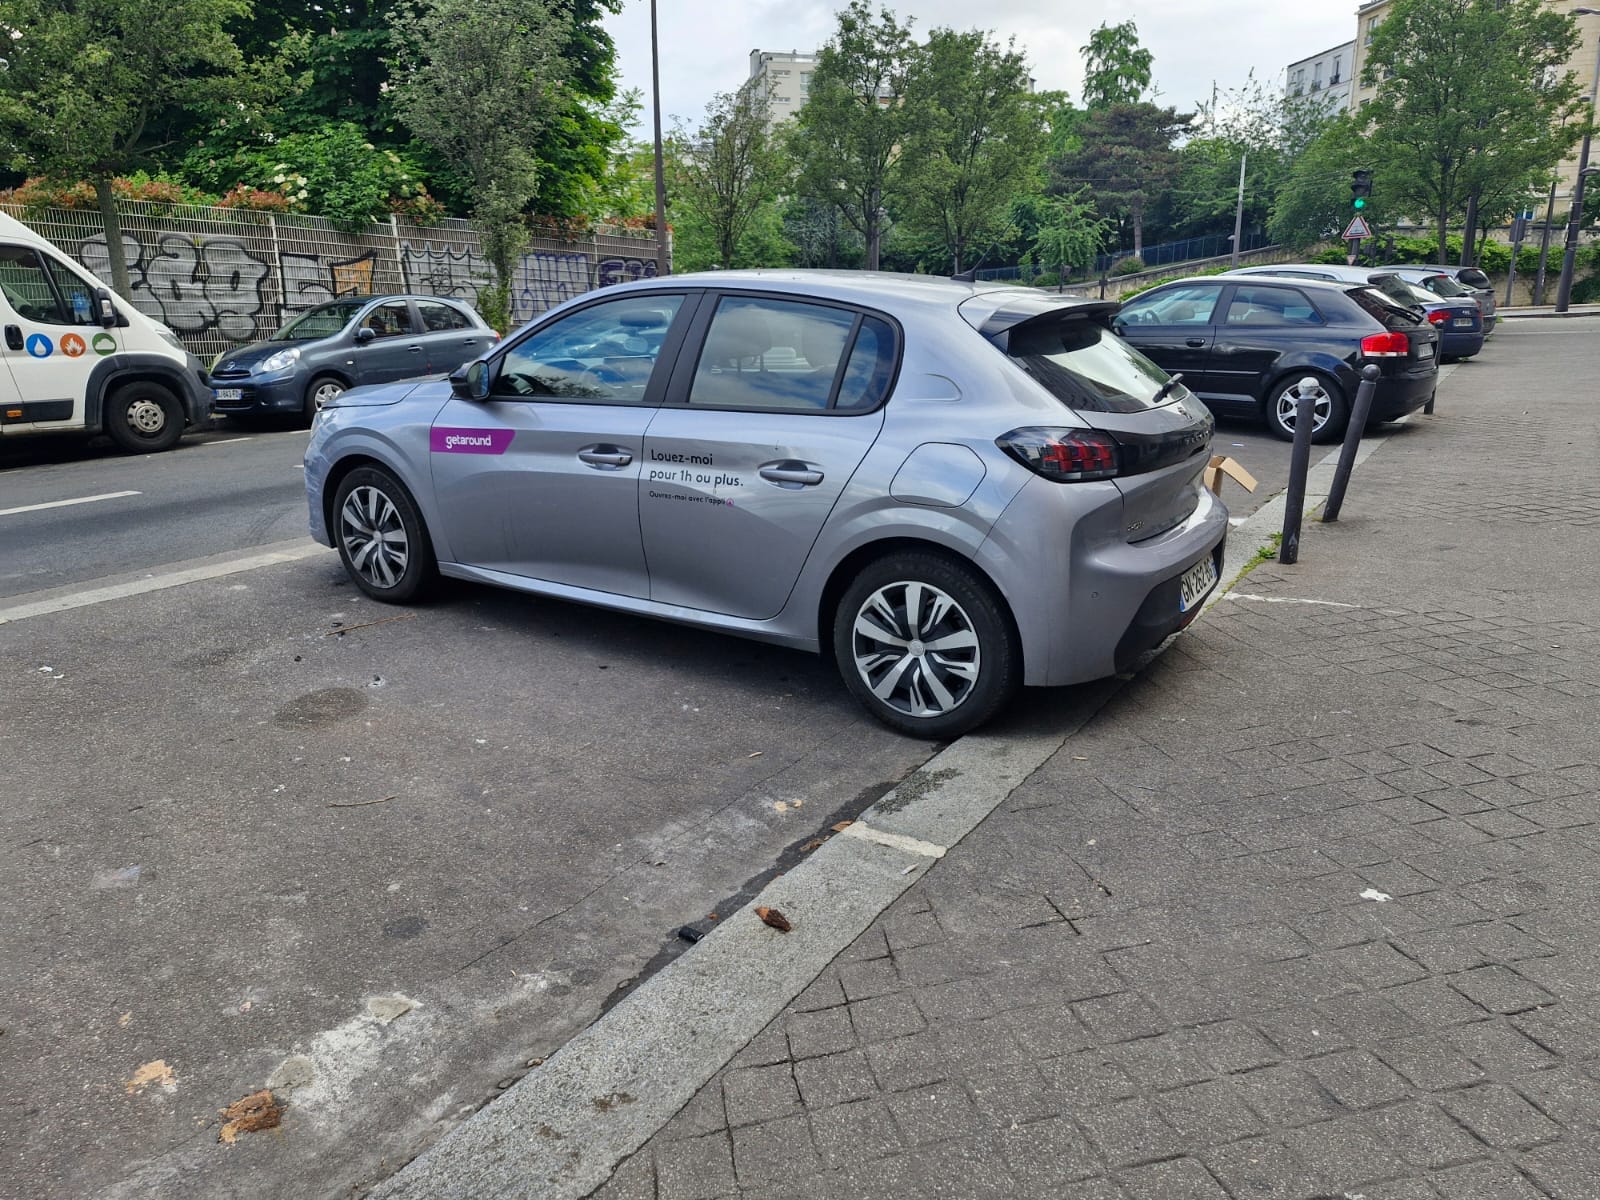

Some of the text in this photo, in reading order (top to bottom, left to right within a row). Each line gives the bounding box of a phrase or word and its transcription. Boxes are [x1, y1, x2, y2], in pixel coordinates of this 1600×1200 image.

[445, 434, 492, 449] getaround
[651, 449, 713, 466] Louez-moi
[650, 470, 744, 488] pour 1h ou plus.
[649, 490, 687, 501] Ouvrez-moi
[689, 496, 704, 504] avec
